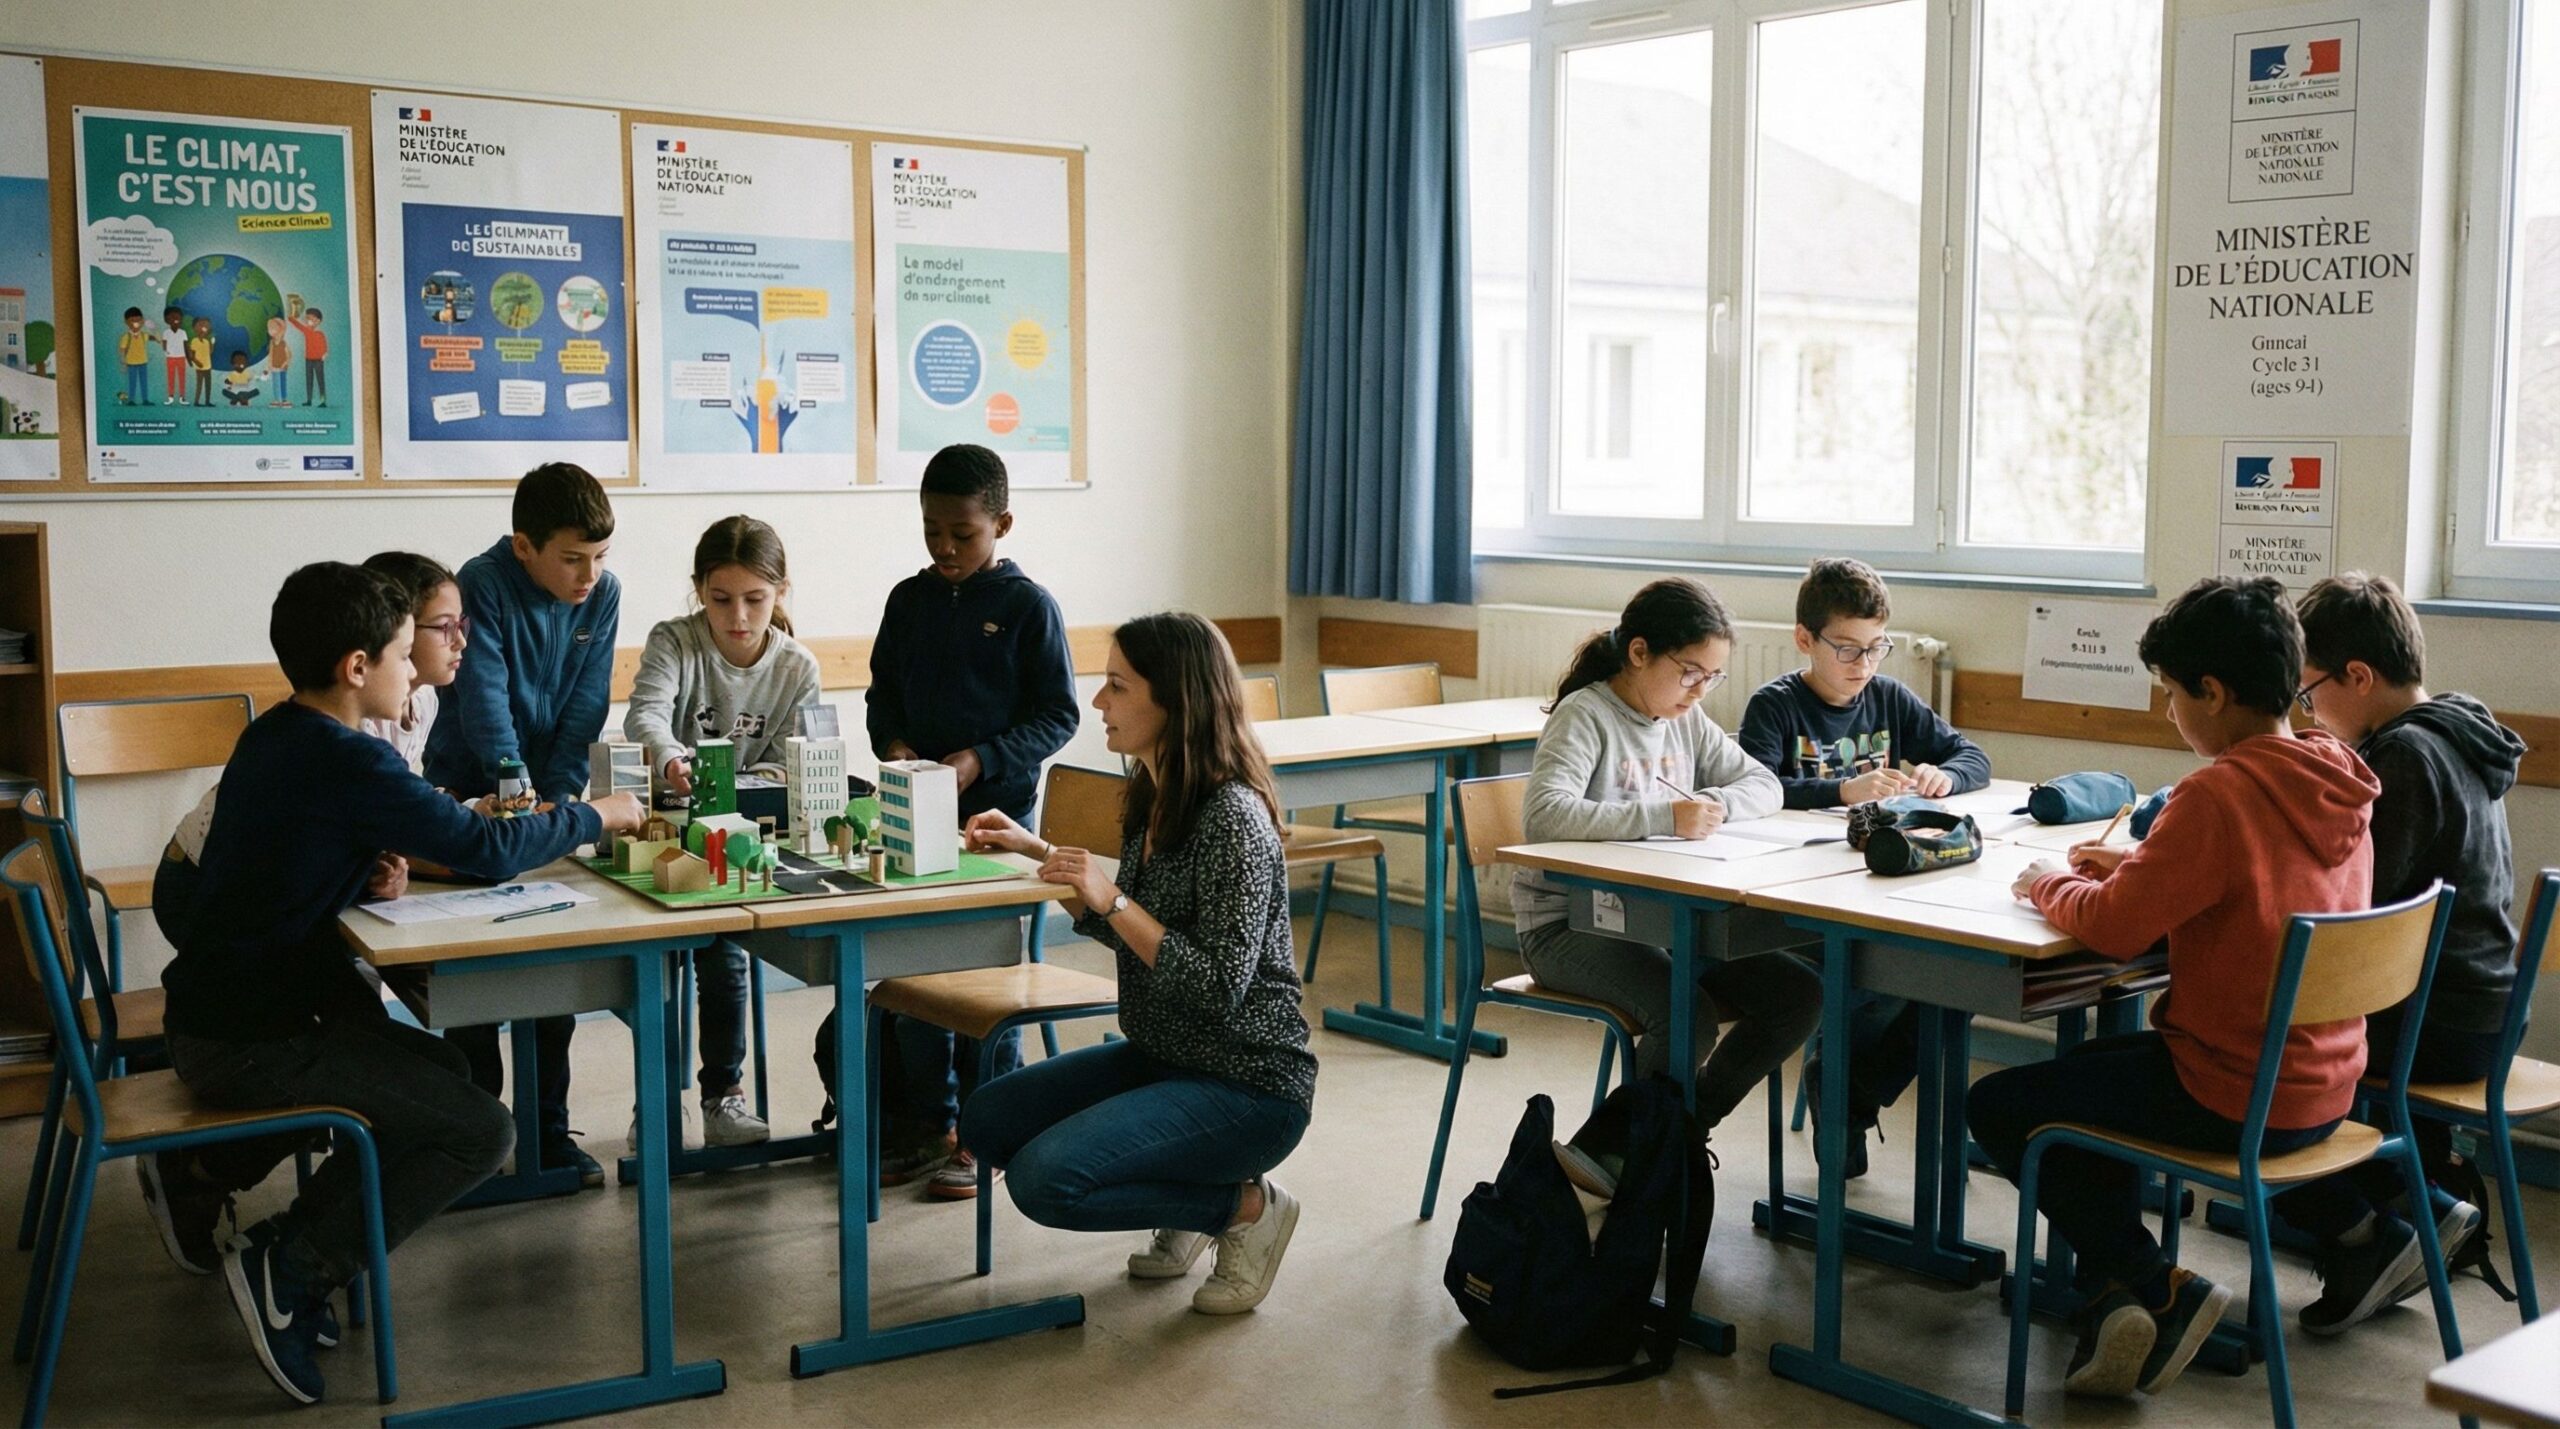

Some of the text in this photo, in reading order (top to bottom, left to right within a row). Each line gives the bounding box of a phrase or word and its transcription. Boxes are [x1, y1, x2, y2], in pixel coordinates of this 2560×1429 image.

[399, 123, 468, 140] MINISTÈRE
[2260, 126, 2324, 144] MINISTÈRE
[400, 137, 505, 156] DE L'ÉDUCATION
[2245, 147, 2260, 159] DE
[124, 133, 308, 179] LE CLIMAT,
[400, 150, 475, 167] NATIONALE
[657, 155, 719, 171] MINISTÈRE
[2259, 156, 2325, 170] NATIONALE
[657, 168, 672, 179] DE
[2258, 169, 2324, 184] NATIONALE
[118, 172, 318, 213] C'EST NOUS
[657, 181, 725, 196] NATIONALE
[241, 218, 287, 229] Science
[2215, 216, 2371, 253] MINISTÈRE
[475, 240, 577, 258] SUSTAINABLES
[904, 255, 919, 269] Le
[2174, 252, 2415, 288] DE L'ÉDUCATION
[2209, 290, 2375, 320] NATIONALE
[2250, 378, 2291, 398] (ages
[2229, 548, 2244, 560] DE
[2243, 561, 2307, 576] NATIONALE
